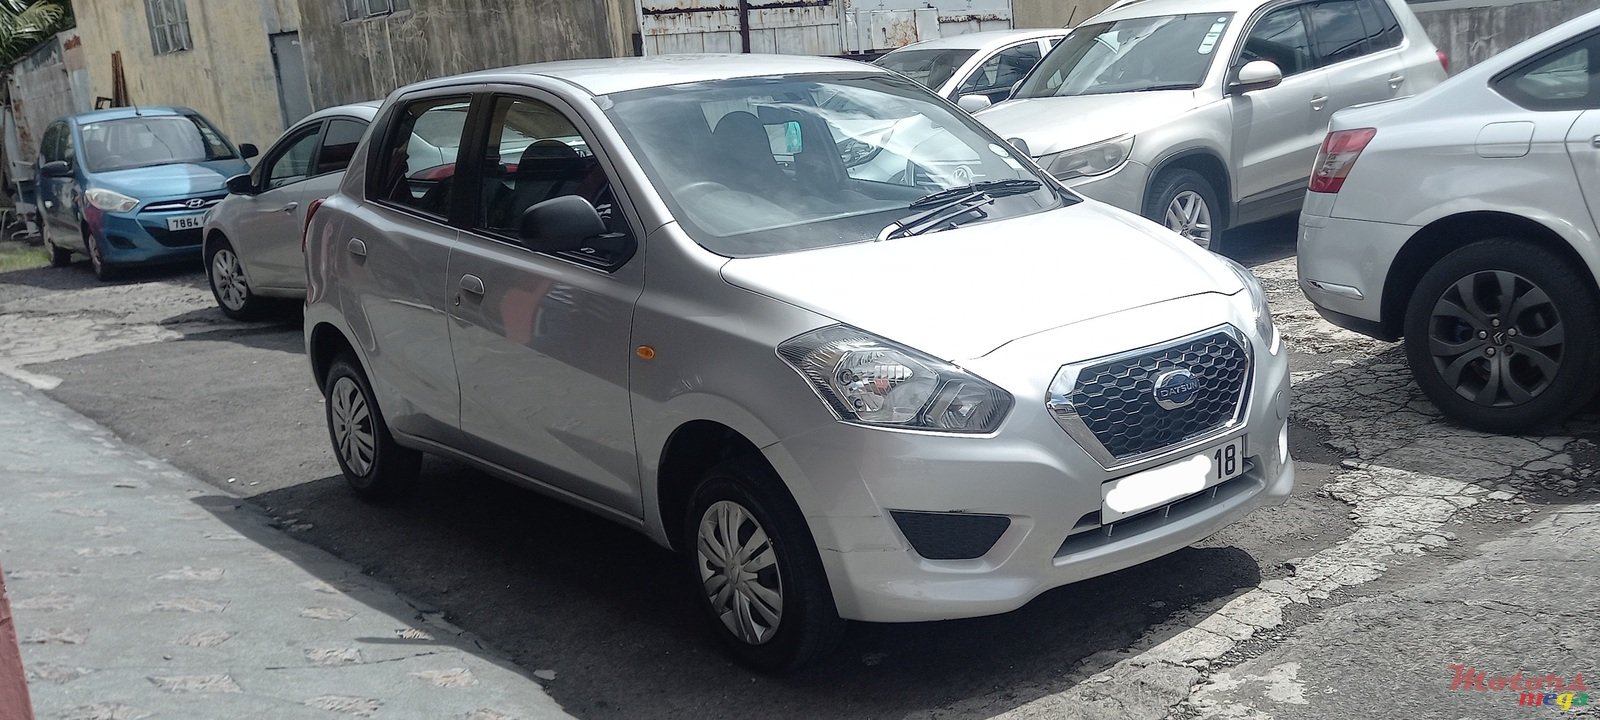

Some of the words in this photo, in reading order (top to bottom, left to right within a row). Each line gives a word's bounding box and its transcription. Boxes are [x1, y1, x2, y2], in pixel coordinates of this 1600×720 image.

[173, 217, 199, 229] 7864
[1160, 380, 1198, 397] DATSUN
[1214, 444, 1236, 479] 18
